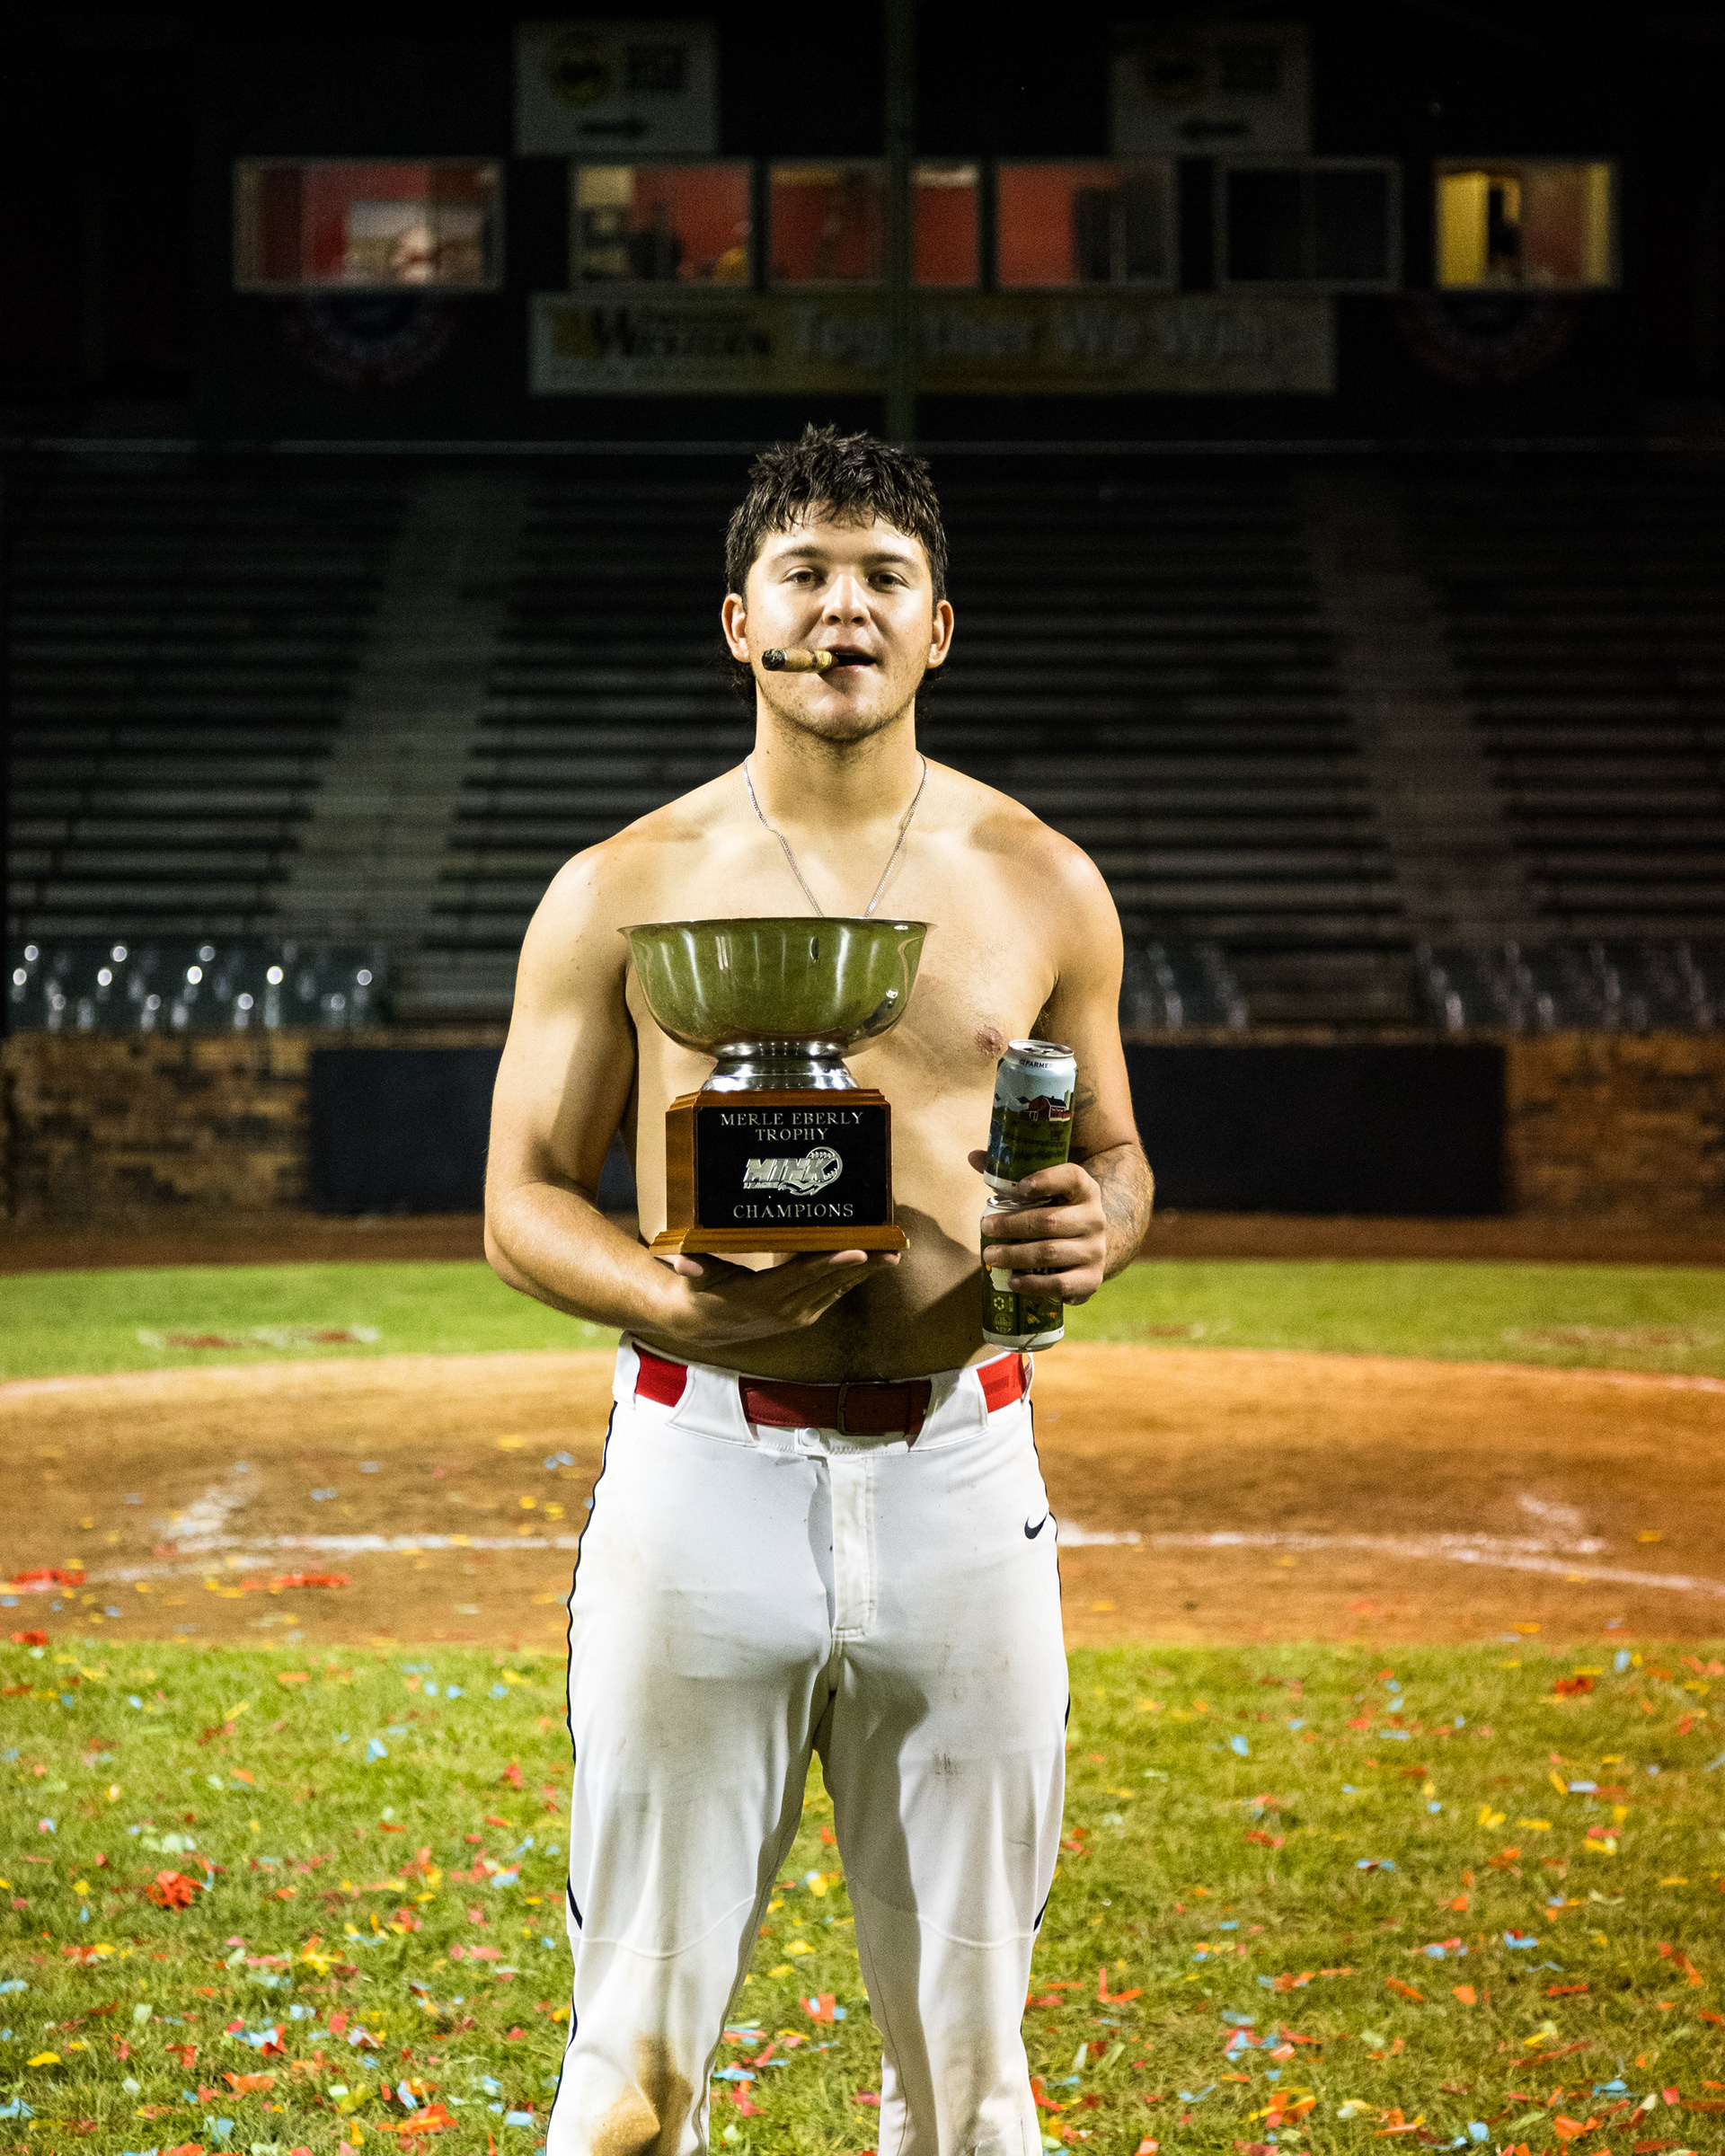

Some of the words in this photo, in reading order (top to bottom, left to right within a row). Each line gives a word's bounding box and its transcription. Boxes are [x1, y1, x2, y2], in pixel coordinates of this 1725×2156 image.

[792, 302, 1033, 367] Togther
[1025, 1060, 1056, 1069] FARMER
[721, 1112, 783, 1127] MERLE
[792, 1111, 864, 1126] EBERLY
[755, 1127, 829, 1142] TROPHY
[742, 1157, 835, 1182] MINK
[733, 1203, 854, 1219] CHAMPIONS
